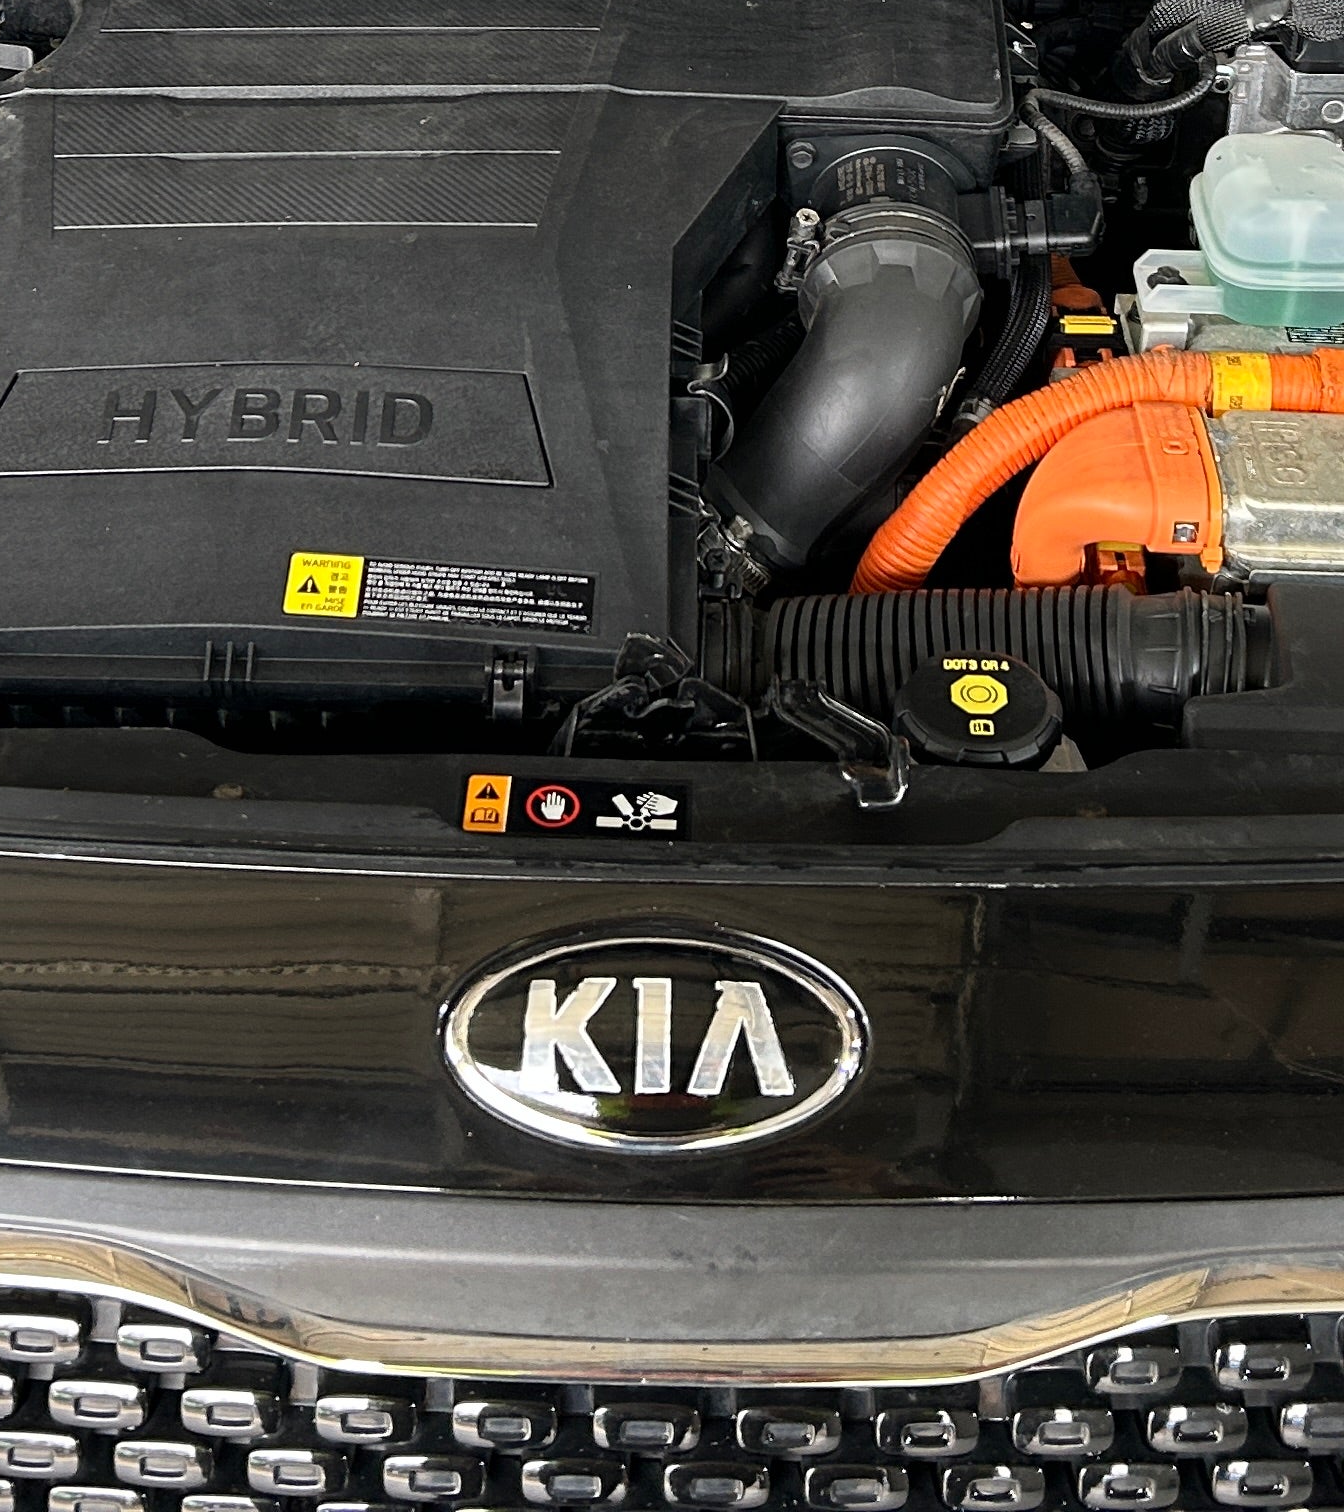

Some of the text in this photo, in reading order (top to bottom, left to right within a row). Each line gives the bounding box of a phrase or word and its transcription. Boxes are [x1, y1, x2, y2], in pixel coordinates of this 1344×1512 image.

[96, 387, 434, 447] HYBRID
[302, 558, 351, 570] WARNING
[980, 659, 999, 671] OR
[1000, 660, 1010, 671] 4
[519, 977, 796, 1095] KIA
